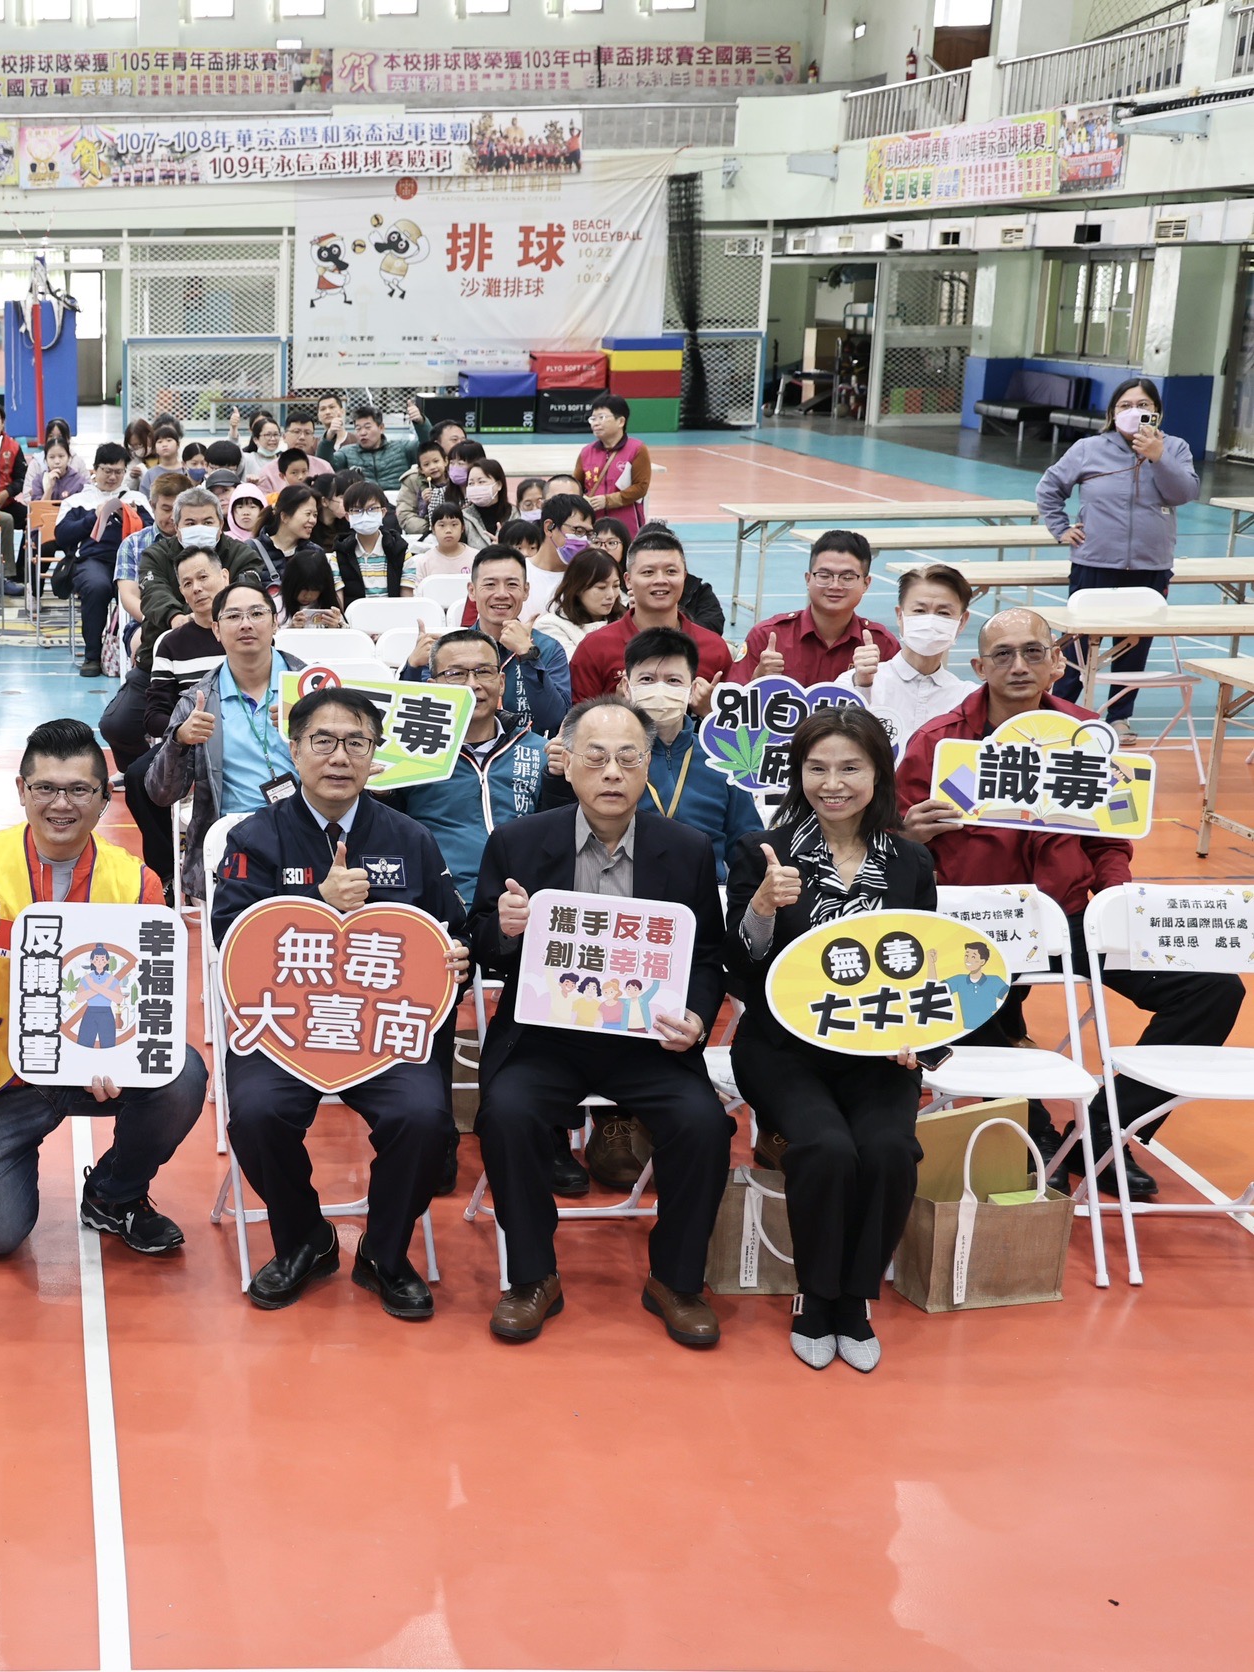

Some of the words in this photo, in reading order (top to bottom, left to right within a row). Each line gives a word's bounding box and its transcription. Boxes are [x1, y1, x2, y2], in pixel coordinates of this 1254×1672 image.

[572, 219, 611, 231] BEACH
[572, 230, 643, 243] VOLLEYBALL
[578, 248, 612, 258] 10/22
[460, 277, 545, 298] 沙灘排球
[978, 744, 1108, 810] 識毒
[1149, 916, 1249, 930] 新聞及國際關係處
[1167, 898, 1228, 910] 臺南市政府
[549, 905, 675, 946] 攜手反毒
[1214, 936, 1242, 949] 處長
[275, 926, 403, 990] 無毒
[544, 940, 671, 980] 創造幸福
[827, 938, 918, 980] 無毒
[19, 914, 63, 1075] 反轉毒害
[136, 919, 175, 1075] 幸福常在
[811, 981, 954, 1037] 大丈夫
[238, 991, 433, 1059] 大臺南
